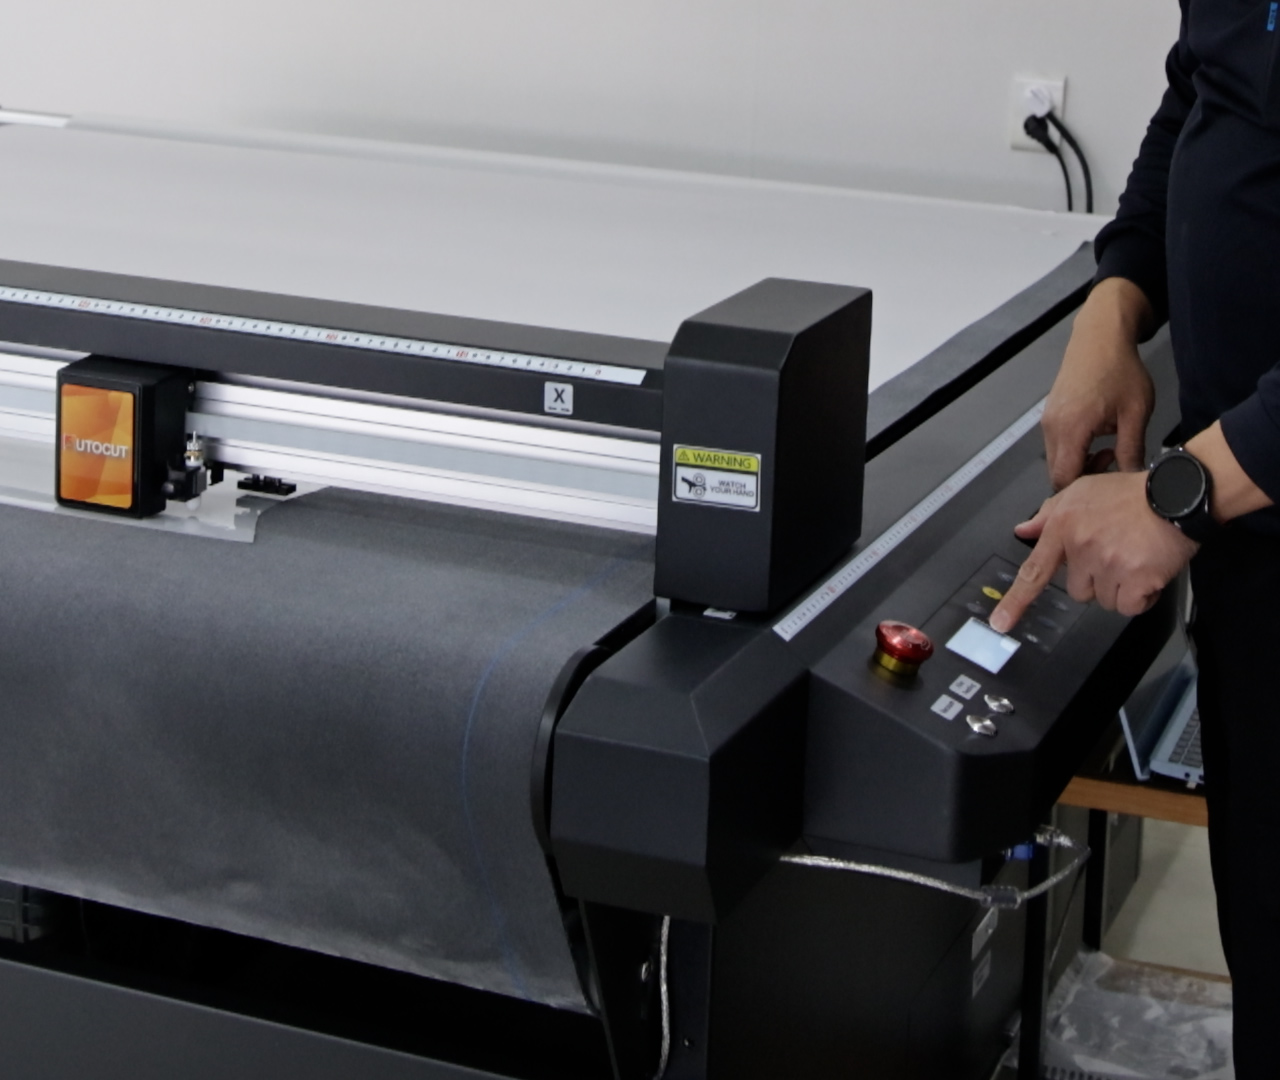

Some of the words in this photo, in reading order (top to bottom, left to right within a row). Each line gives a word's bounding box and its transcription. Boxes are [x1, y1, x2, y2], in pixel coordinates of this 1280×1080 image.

[553, 387, 565, 404] X
[692, 451, 752, 469] WARNING
[709, 485, 732, 496] YOUR
[733, 488, 755, 498] HAND
[718, 479, 747, 490] WATCH
